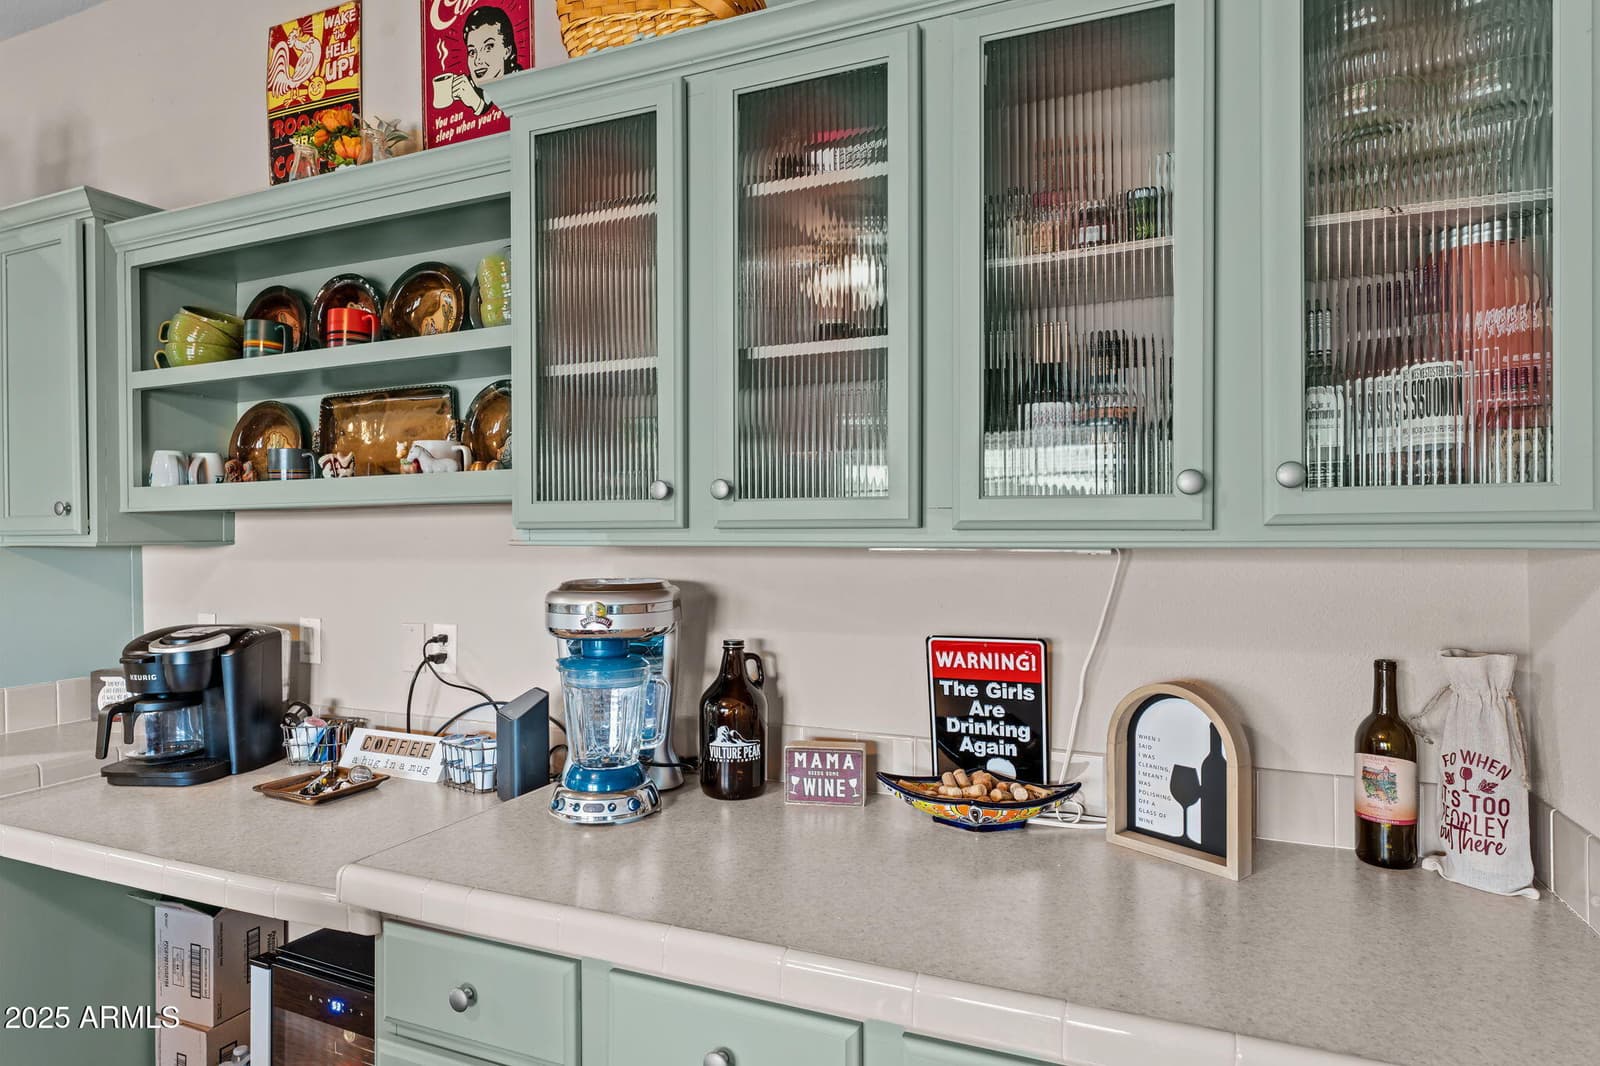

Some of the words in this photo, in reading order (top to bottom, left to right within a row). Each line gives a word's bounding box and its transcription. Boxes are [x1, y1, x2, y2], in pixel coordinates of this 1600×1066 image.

[324, 8, 356, 29] WAKE
[333, 28, 347, 40] the
[325, 39, 355, 59] HELL
[325, 55, 355, 82] UP!
[435, 115, 448, 130] You
[450, 111, 464, 124] can
[435, 128, 454, 143] sleep
[456, 120, 476, 134] when
[478, 109, 502, 130] you're
[935, 650, 1037, 672] WARNING!
[939, 679, 979, 698] The
[985, 681, 1036, 701] Girls
[968, 699, 1006, 718] Are
[946, 716, 1031, 743] Drinking
[1138, 734, 1156, 742] WHEN
[362, 736, 432, 758] COFFEE
[709, 744, 742, 759] VULTURE
[743, 743, 761, 759] PEAK
[959, 735, 1018, 757] Again
[351, 756, 358, 764] a
[361, 755, 381, 769] hug
[384, 758, 396, 769] in
[398, 762, 405, 770] a
[408, 764, 431, 776] mug
[794, 752, 855, 770] MAMA
[1460, 749, 1512, 781] WHEN
[1142, 772, 1163, 781] MEANT
[803, 777, 846, 797] WINE
[1138, 789, 1172, 802] POLISHING
[1138, 807, 1157, 817] GLASS
[1468, 794, 1511, 817] TOO
[1138, 817, 1154, 825] WINE
